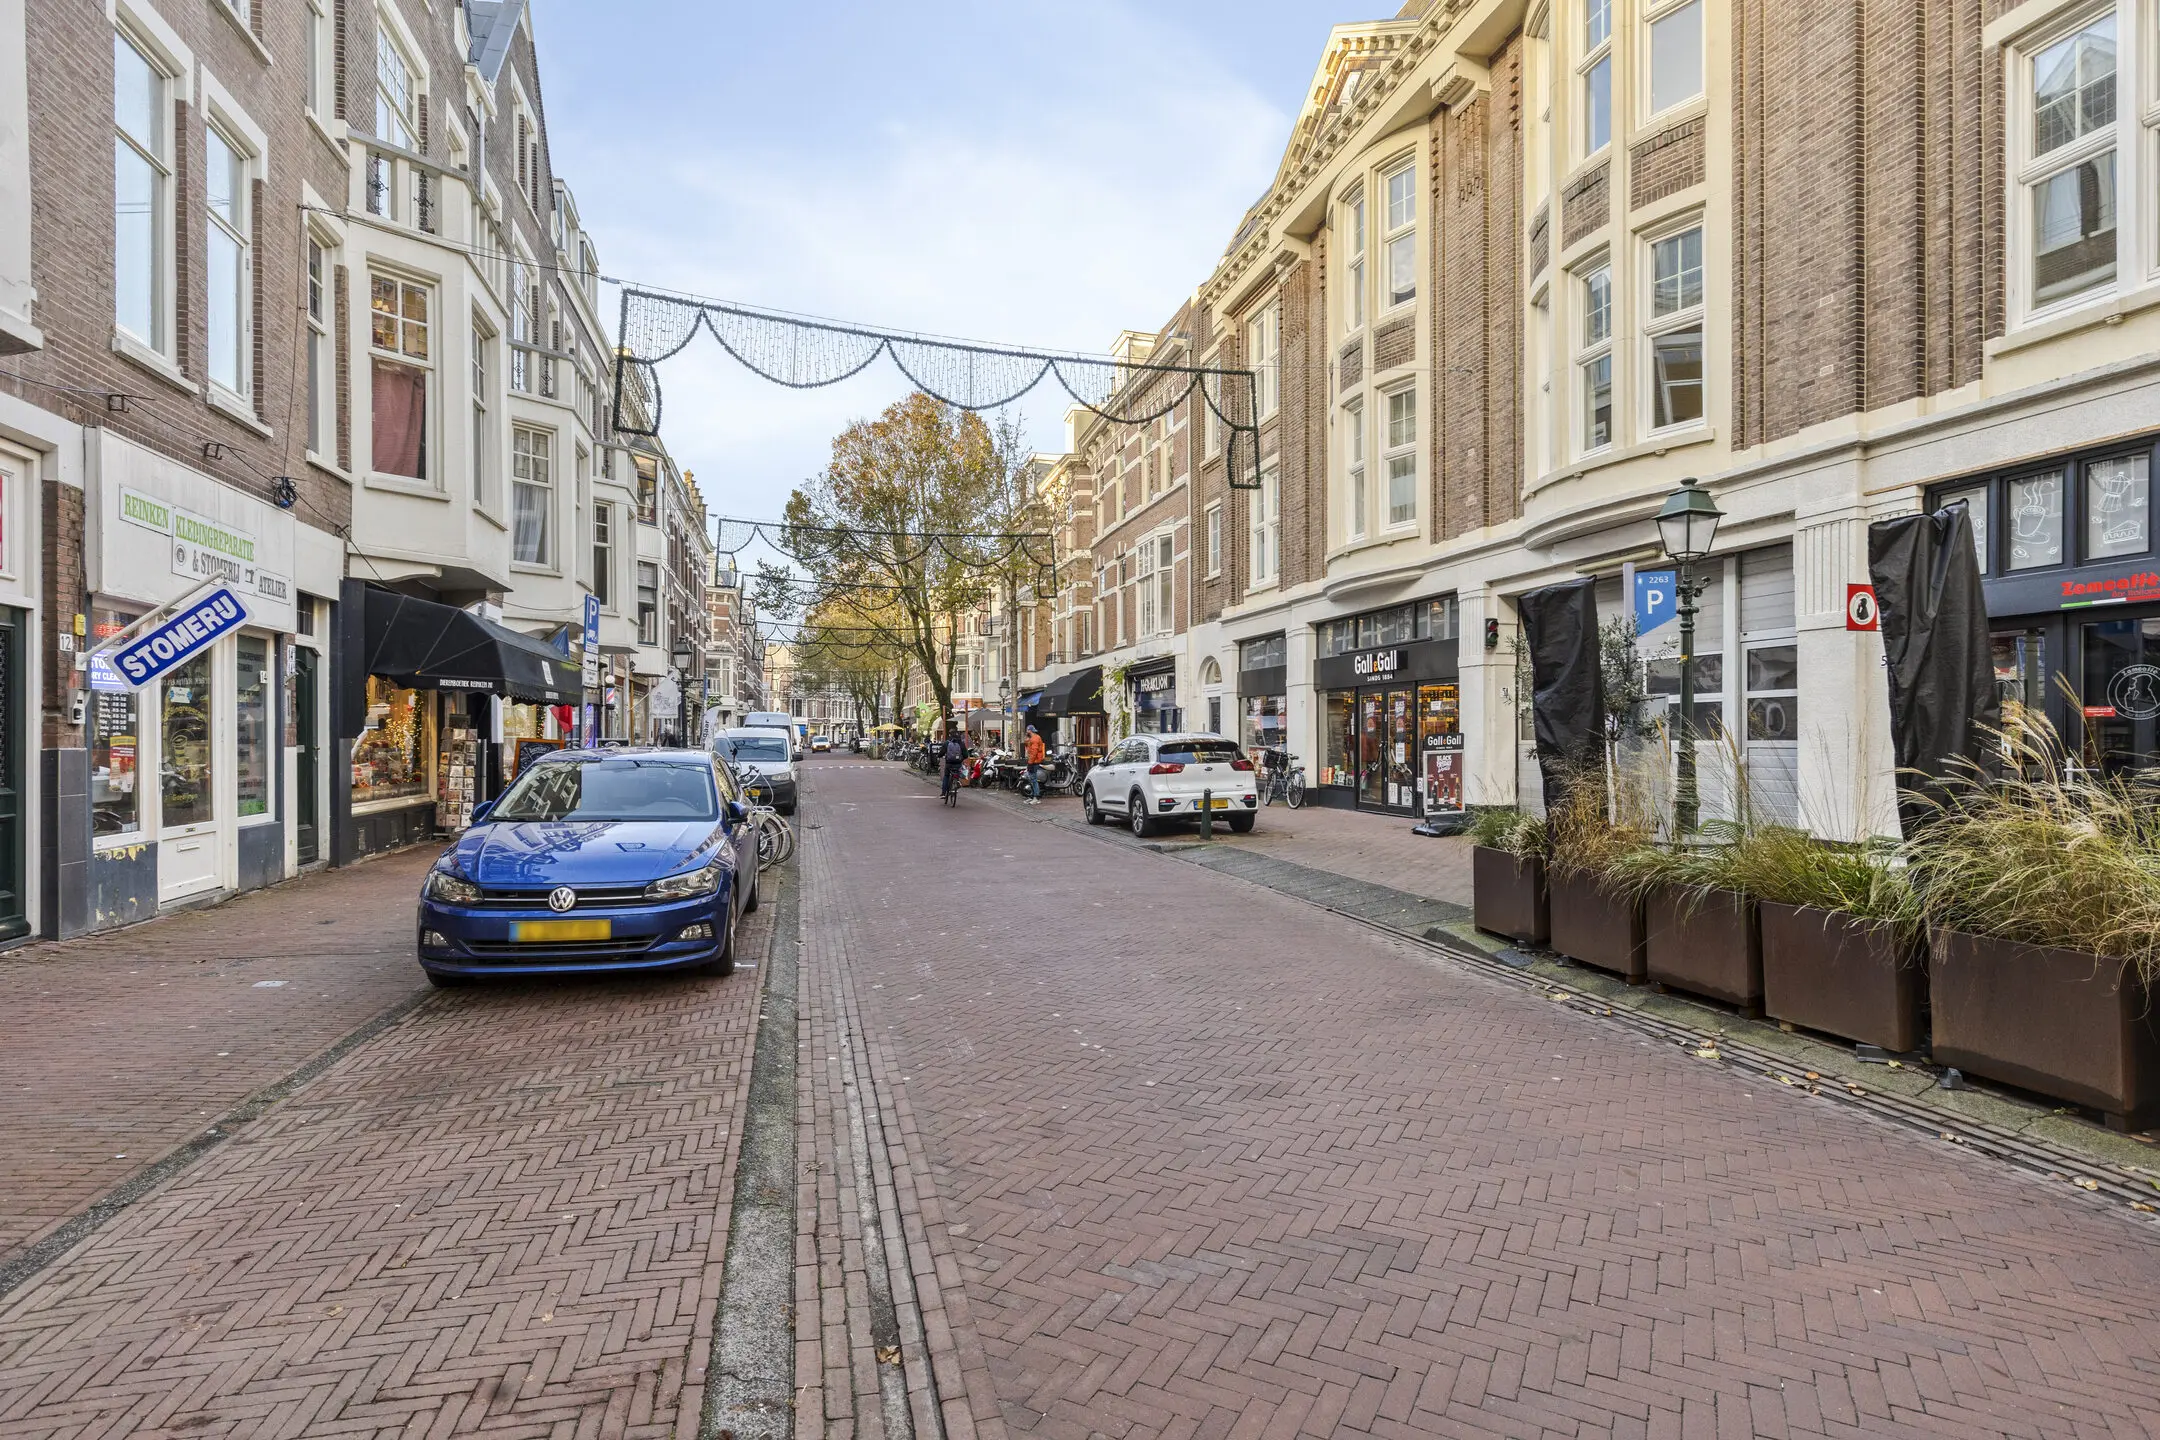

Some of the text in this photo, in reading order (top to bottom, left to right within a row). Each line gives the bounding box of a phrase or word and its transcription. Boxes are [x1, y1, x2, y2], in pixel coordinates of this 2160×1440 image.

[124, 493, 255, 562] REINKEN KLEDINGREPARATIE
[258, 575, 287, 599] ATELIER
[1648, 575, 1669, 584] 2263
[588, 600, 598, 624] P
[1647, 589, 1664, 615] P
[61, 635, 71, 651] 12
[1366, 673, 1394, 682] SINDS 1884
